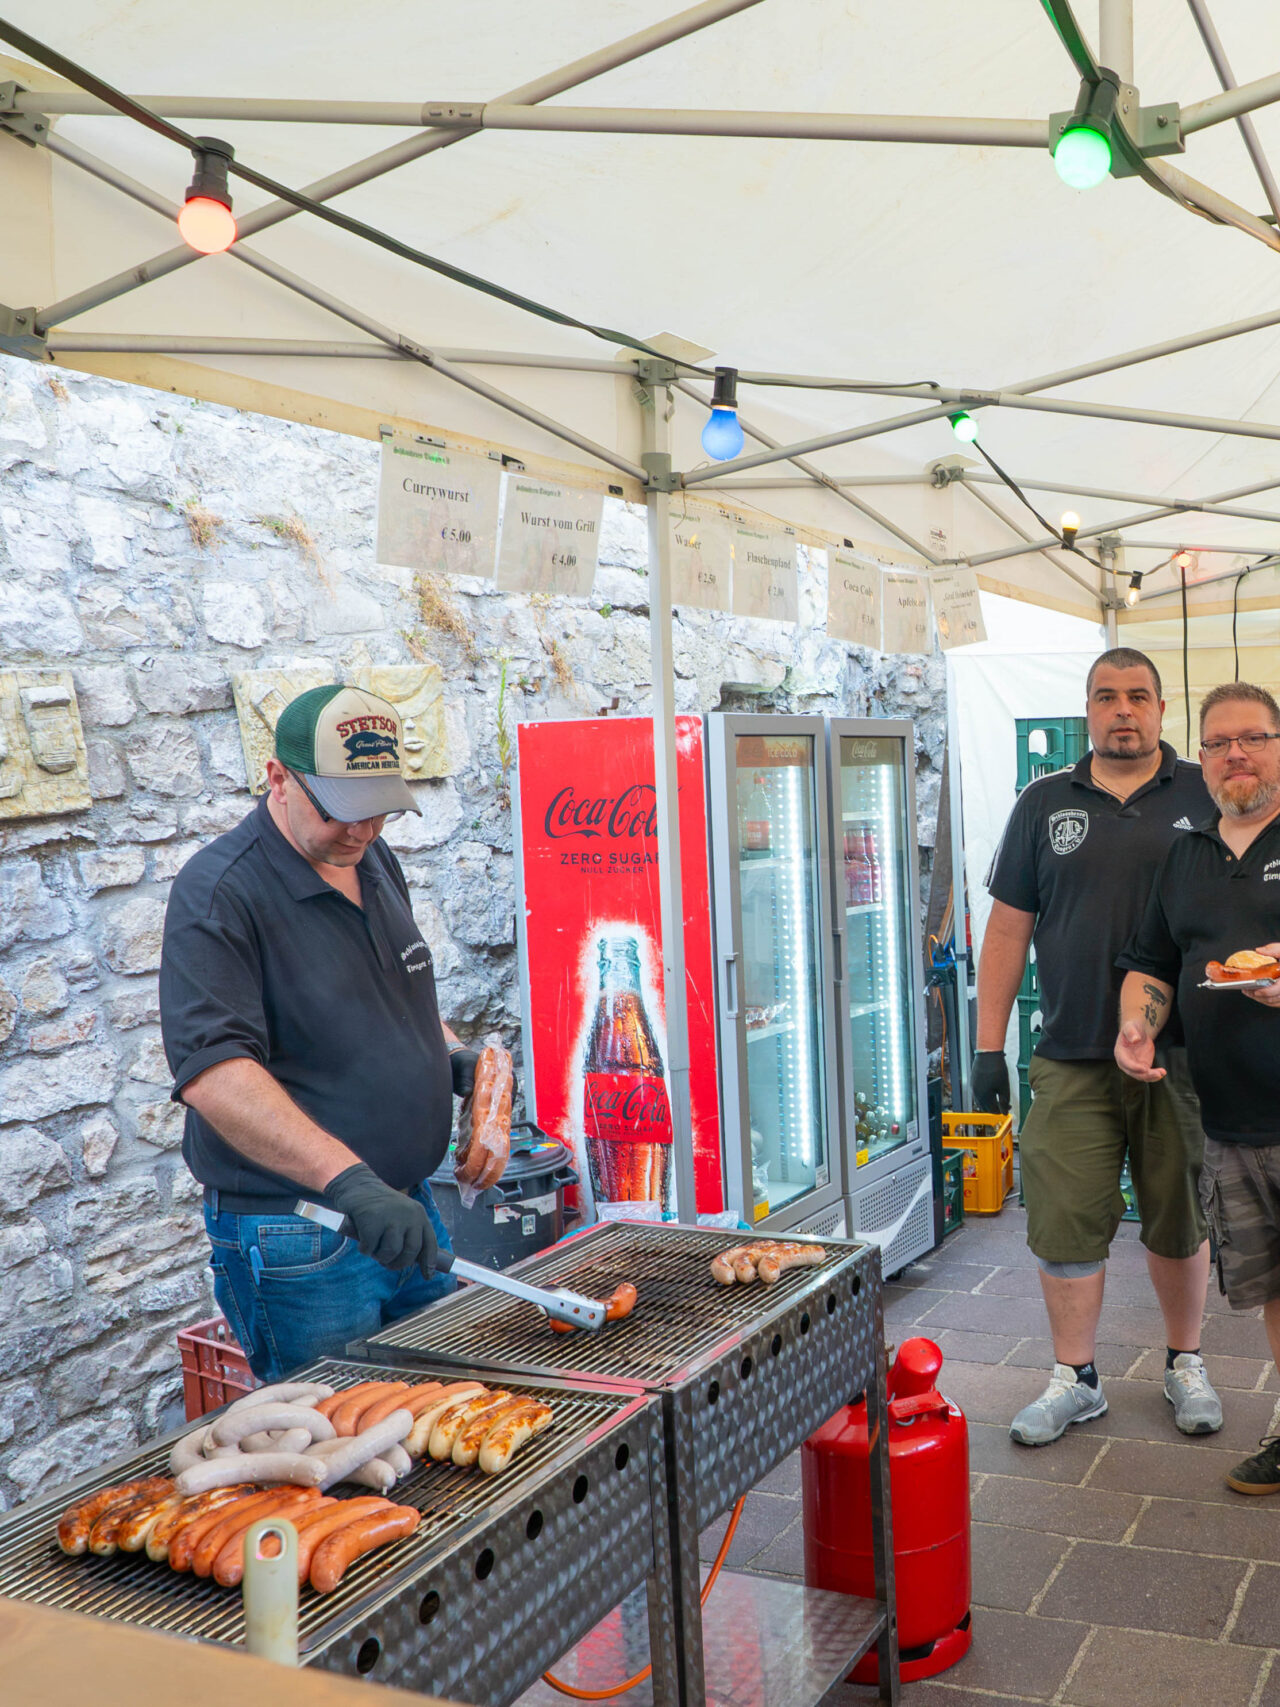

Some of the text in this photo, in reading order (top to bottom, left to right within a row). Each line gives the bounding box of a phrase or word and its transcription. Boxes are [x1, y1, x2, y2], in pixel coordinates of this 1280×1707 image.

[402, 477, 470, 503] Currywurst
[520, 511, 596, 533] Wurst vom Grill
[441, 526, 449, 540] €
[551, 553, 558, 566] €
[843, 579, 860, 593] Coca
[335, 715, 398, 738] STETSON
[346, 761, 380, 771] AMERICAN
[544, 784, 658, 839] Coca-Col
[560, 853, 659, 865] ZERO SUGA
[581, 866, 644, 874] NULL ZUCKER
[584, 1081, 666, 1122] Coca-Cola
